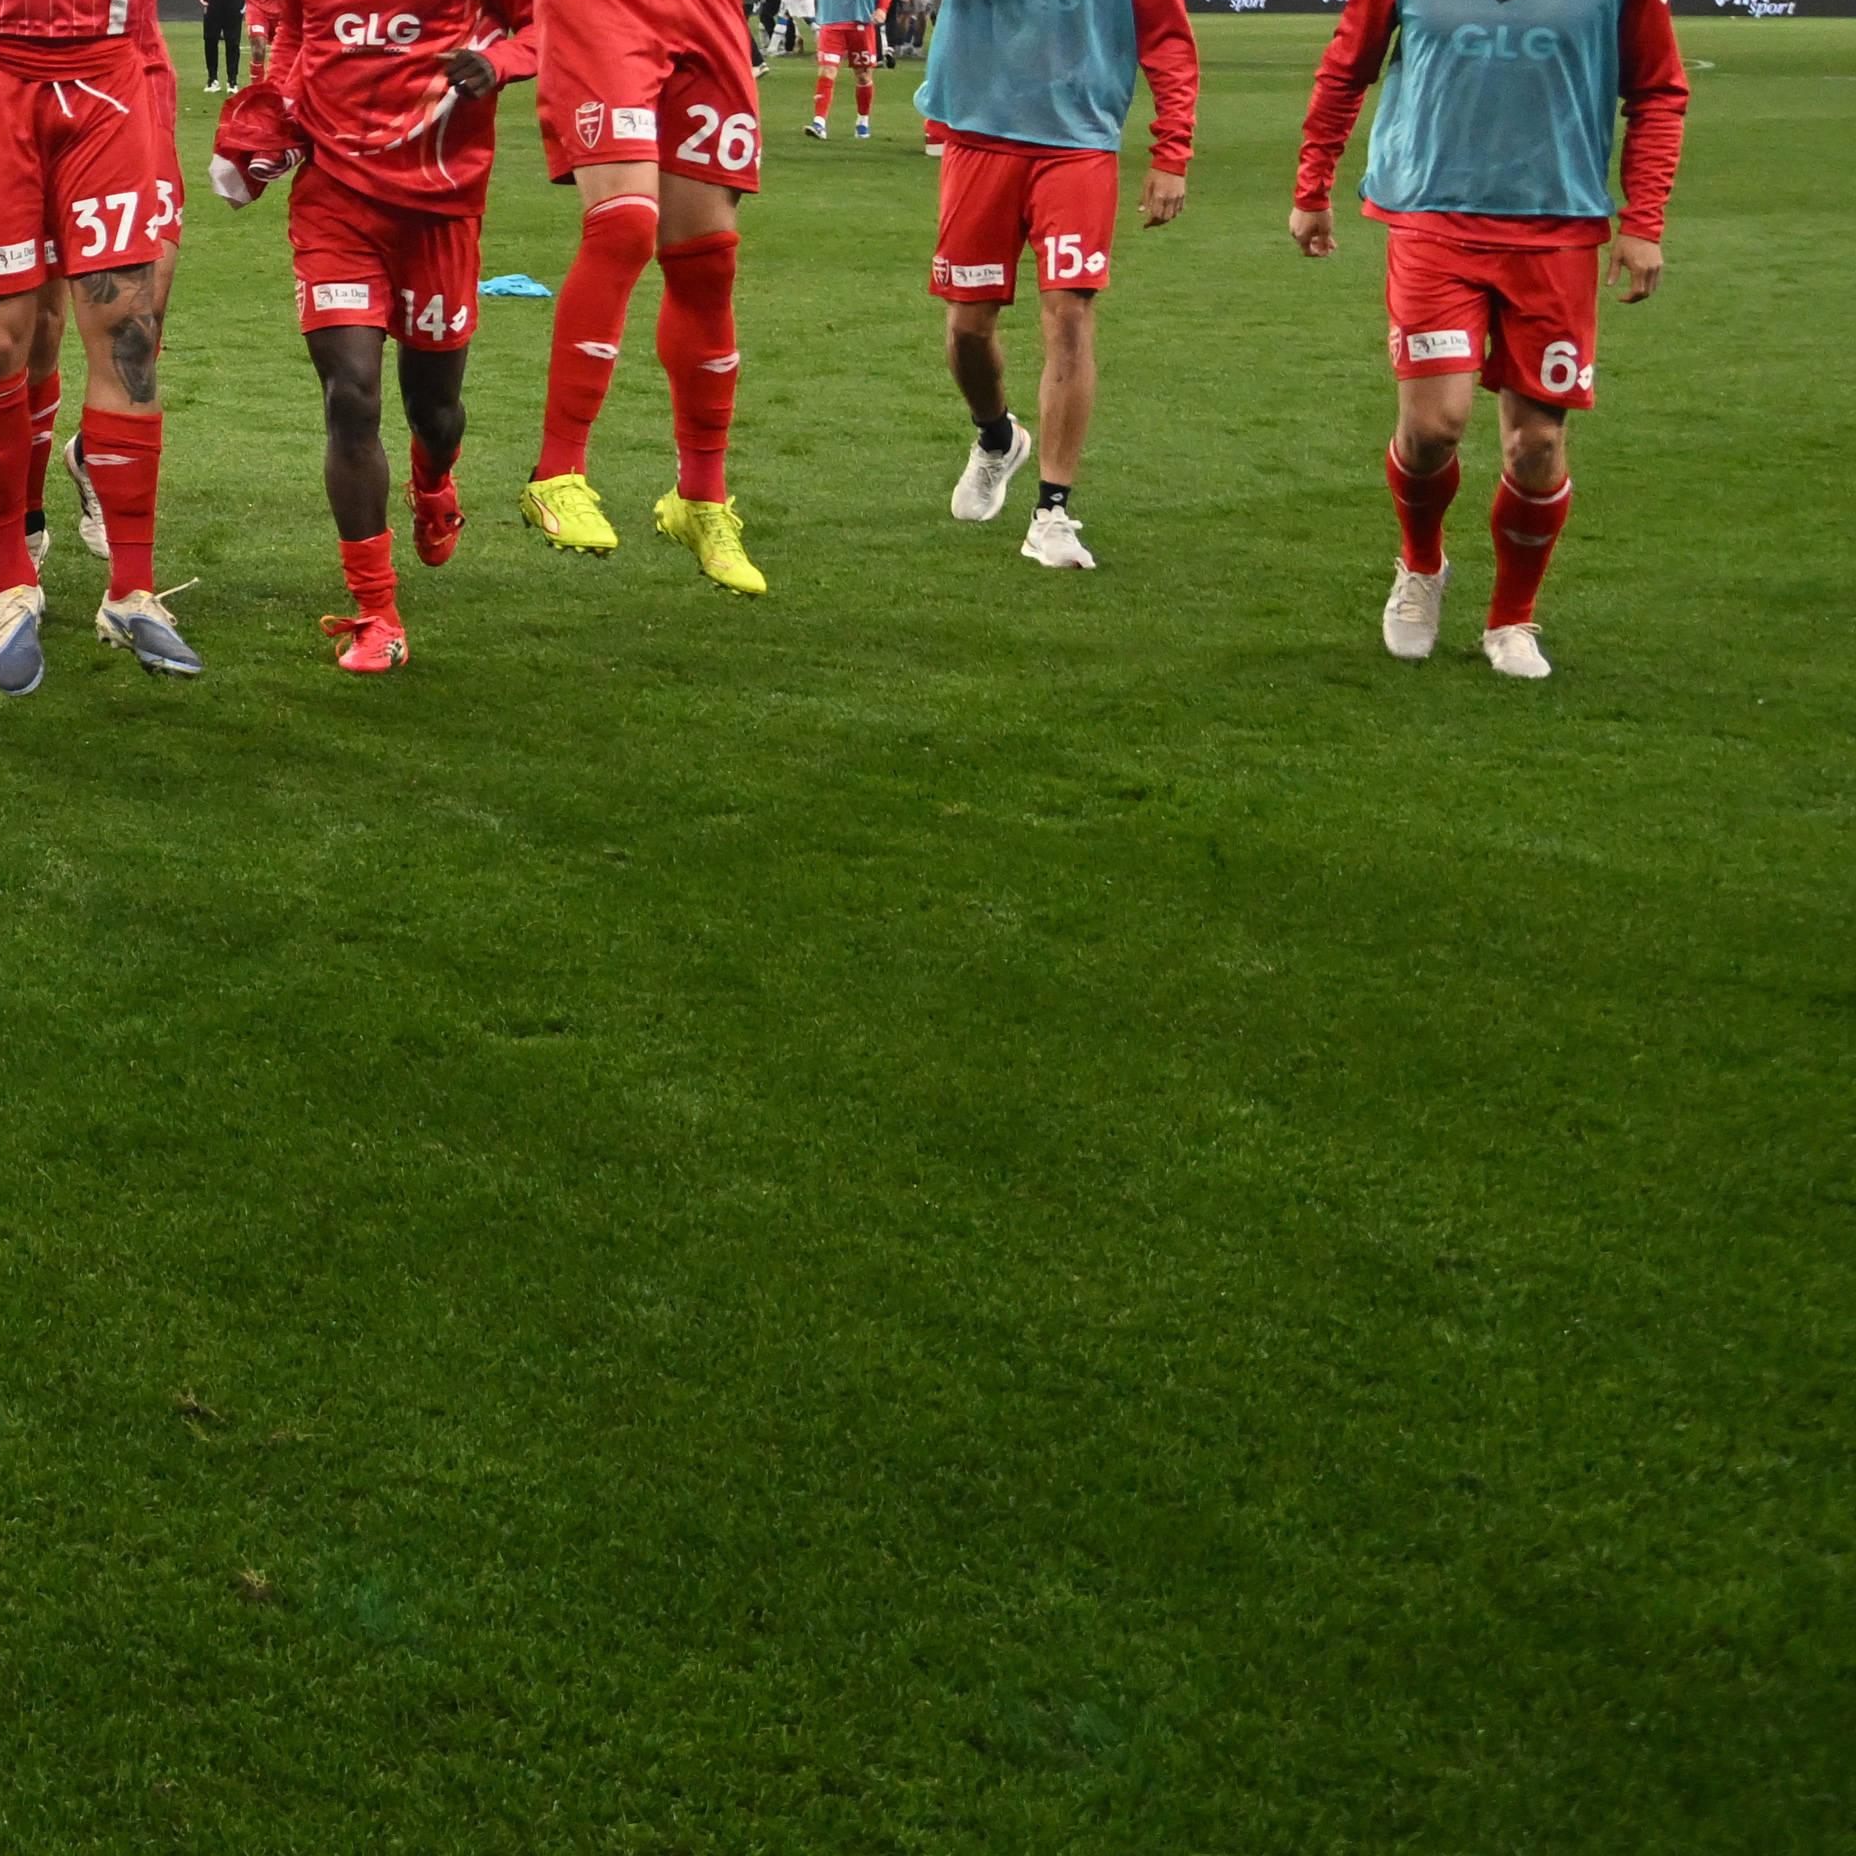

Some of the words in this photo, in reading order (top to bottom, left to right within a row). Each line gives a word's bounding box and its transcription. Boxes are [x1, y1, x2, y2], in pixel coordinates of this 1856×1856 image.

[334, 12, 421, 46] GLG
[1748, 1, 1796, 18] sport
[1452, 23, 1560, 61] GLG
[676, 104, 756, 171] 26
[72, 191, 138, 258] 37
[1044, 233, 1083, 281] 15
[401, 288, 446, 342] 14
[1540, 341, 1578, 393] 6
